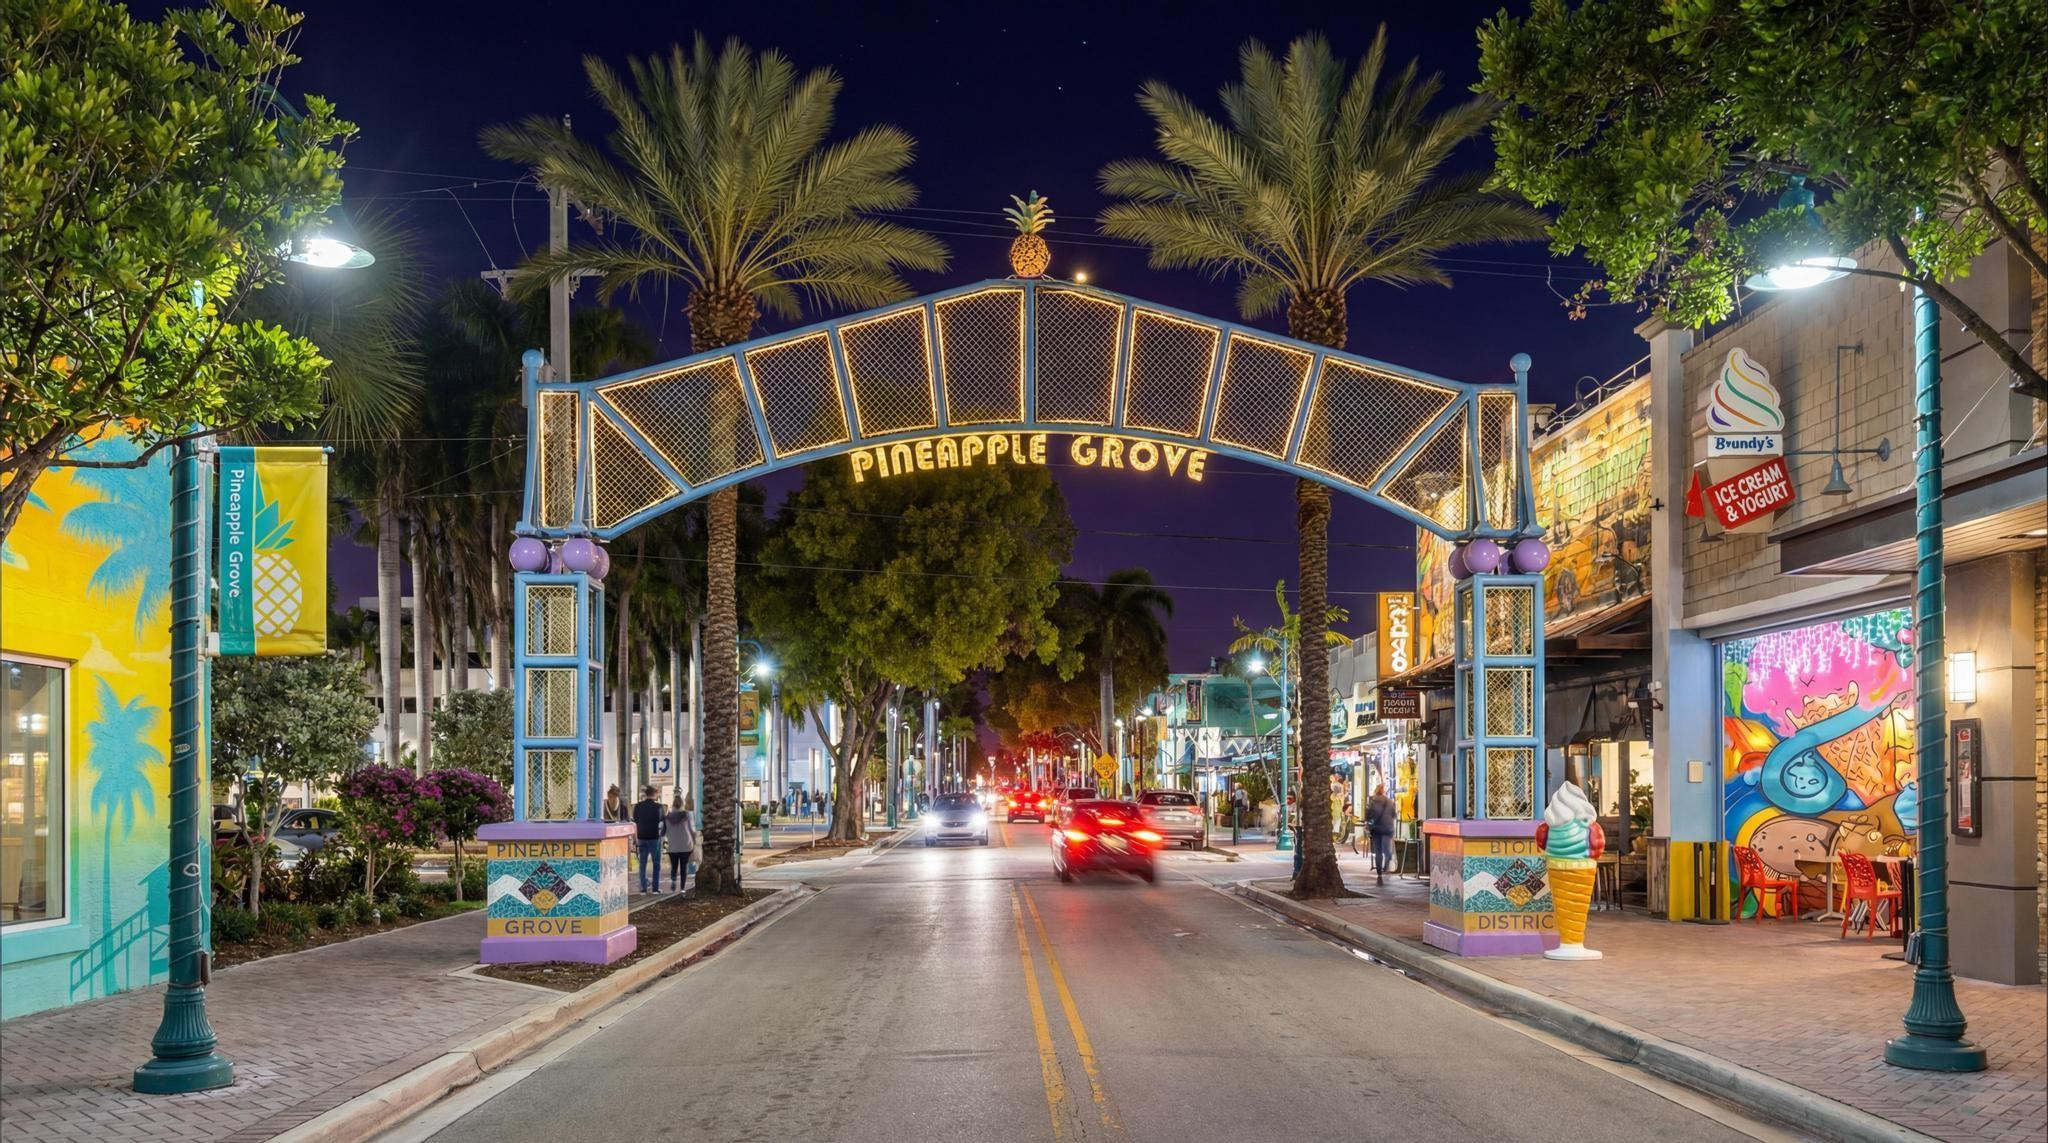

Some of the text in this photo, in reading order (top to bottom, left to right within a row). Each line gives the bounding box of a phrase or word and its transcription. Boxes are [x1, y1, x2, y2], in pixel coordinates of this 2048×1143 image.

[851, 433, 1208, 483] PINEAPPLE GROVE
[1714, 463, 1784, 507] ICE CREAM
[1725, 481, 1789, 522] & YOGURT
[225, 469, 245, 598] Pineapple Grove
[496, 843, 596, 858] PINEAPPLE
[504, 920, 583, 934] GROVE
[1478, 914, 1554, 930] DISTRIC
